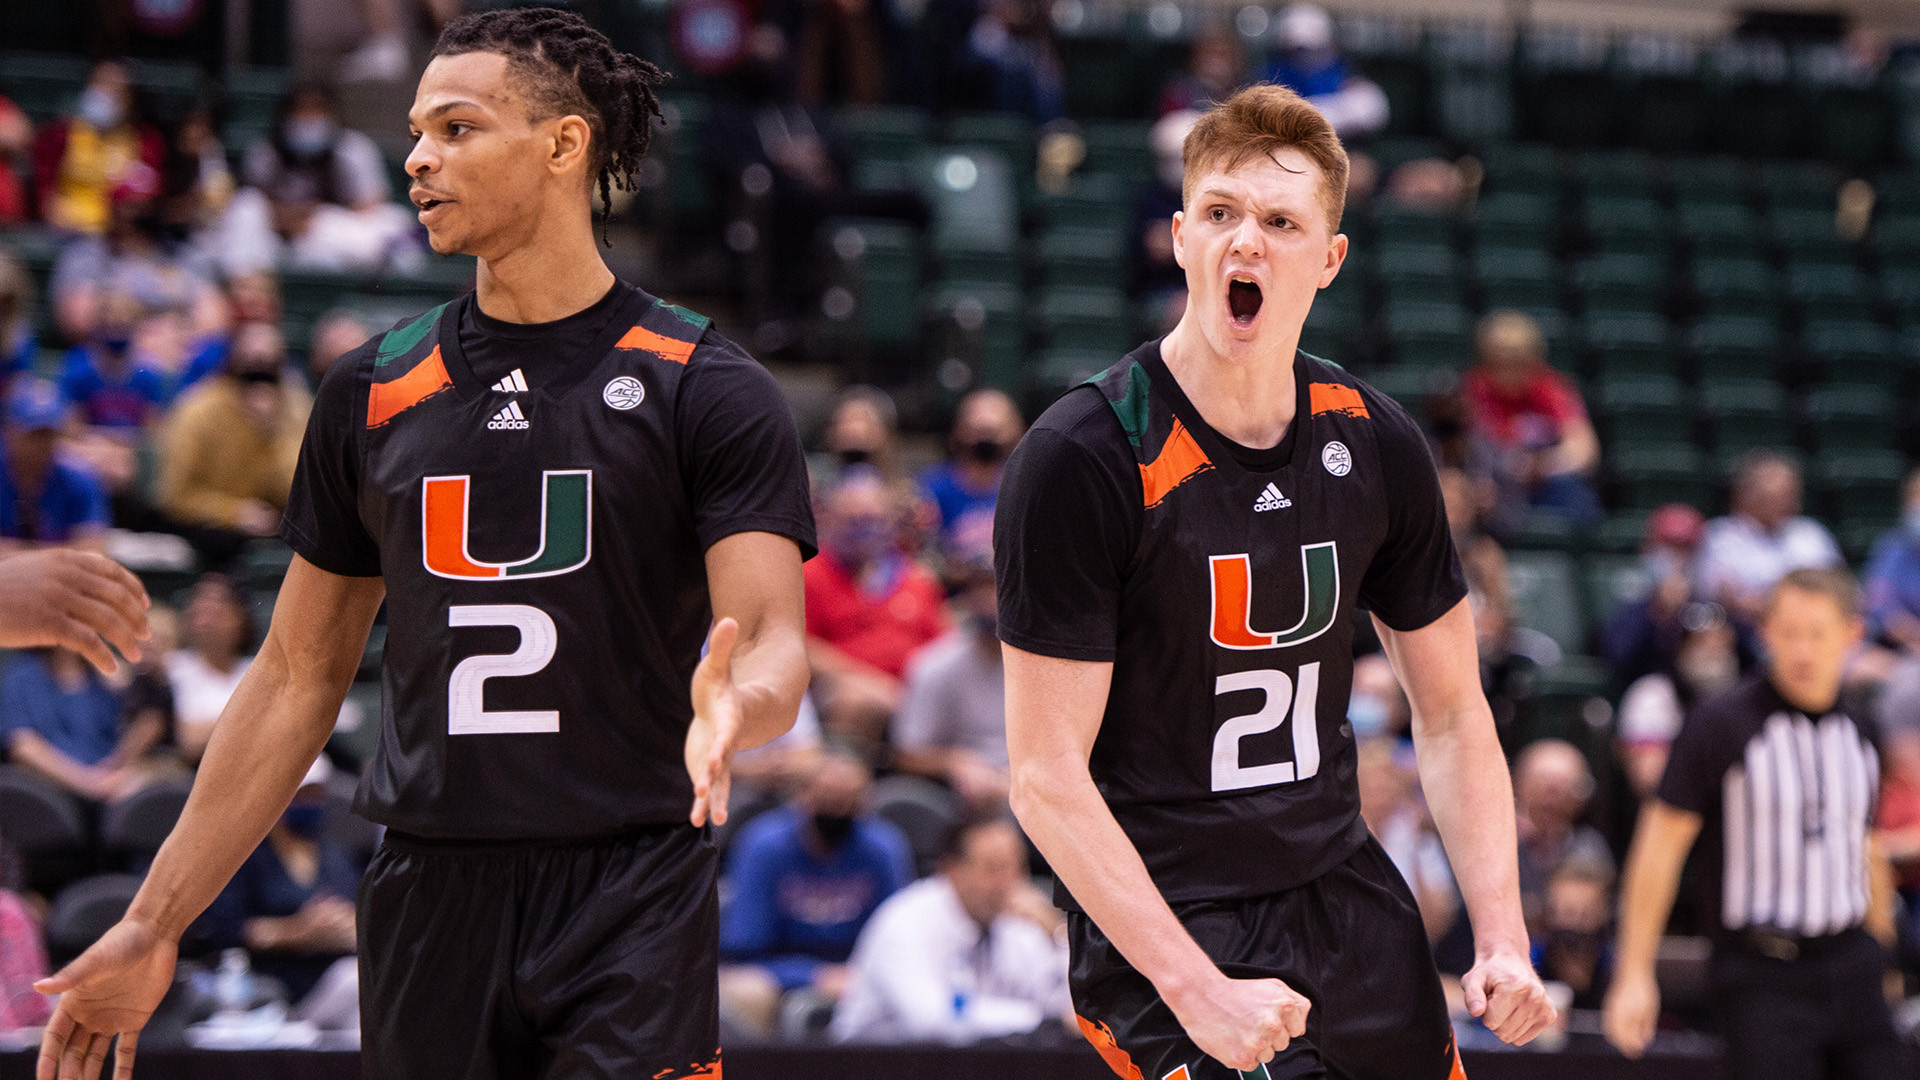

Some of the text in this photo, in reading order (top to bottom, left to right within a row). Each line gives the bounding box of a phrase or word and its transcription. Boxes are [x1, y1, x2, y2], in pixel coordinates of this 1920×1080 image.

[610, 388, 641, 397] ACC
[487, 419, 530, 430] adidas
[1327, 452, 1347, 461] ACC
[422, 469, 593, 581] U
[1253, 498, 1293, 512] adidas
[1208, 540, 1341, 650] U
[448, 604, 560, 735] 2
[1211, 661, 1320, 792] 21
